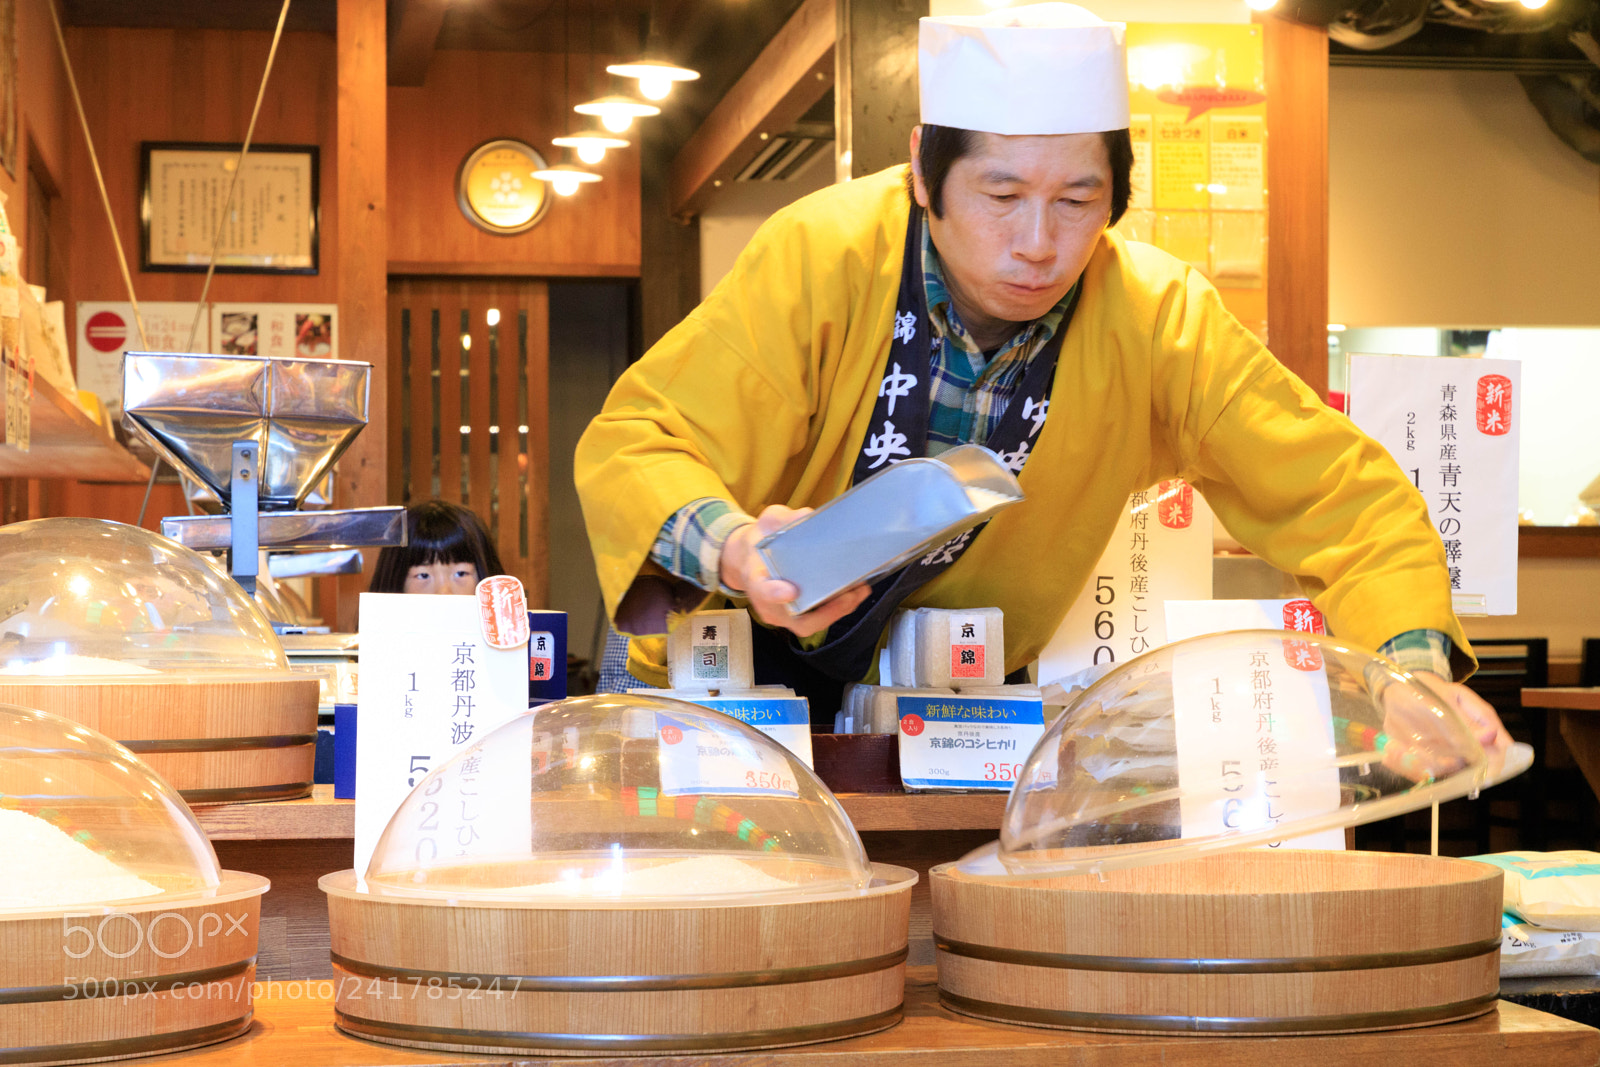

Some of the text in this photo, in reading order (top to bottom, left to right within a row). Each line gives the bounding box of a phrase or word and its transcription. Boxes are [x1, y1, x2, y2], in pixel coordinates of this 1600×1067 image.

[1484, 383, 1504, 433] 新米
[1406, 411, 1416, 451] 2kg
[534, 635, 546, 677] 京錦
[702, 625, 717, 666] 寿司
[960, 623, 976, 665] 京錦
[404, 672, 419, 718] 1kg
[925, 703, 1017, 719] 新鮮な味わい
[929, 737, 1016, 750] 京錦のコシヒカリ
[928, 768, 950, 776] 300g
